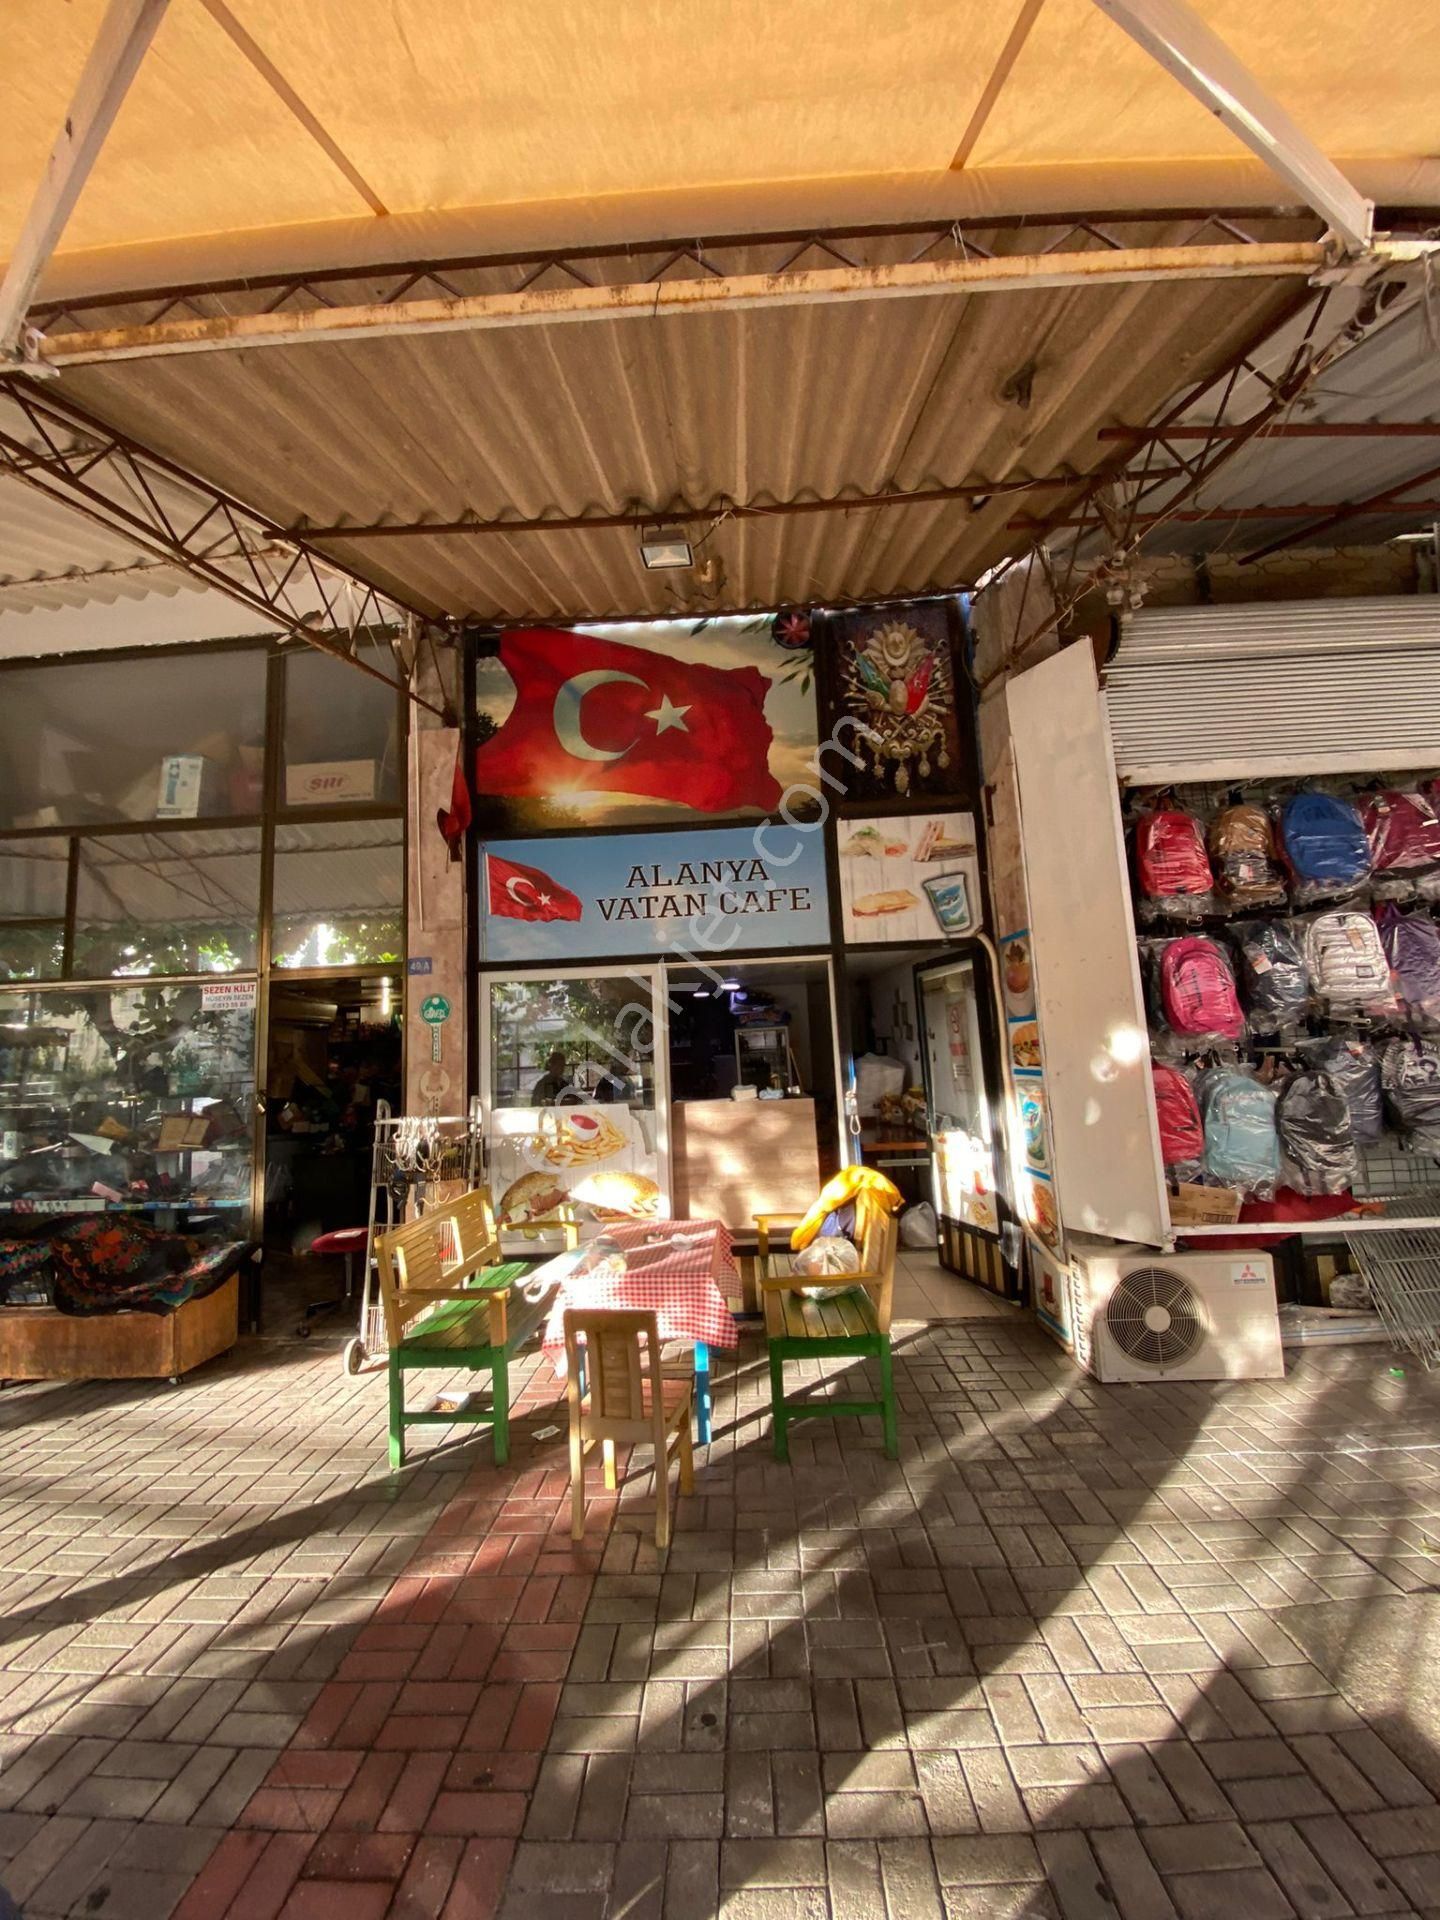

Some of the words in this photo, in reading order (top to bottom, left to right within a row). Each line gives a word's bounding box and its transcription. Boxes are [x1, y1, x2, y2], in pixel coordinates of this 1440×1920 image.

[625, 858, 770, 888] ALANYA
[596, 893, 708, 921] VATAN
[719, 887, 811, 915] CAFE
[203, 985, 231, 995] SEZEN
